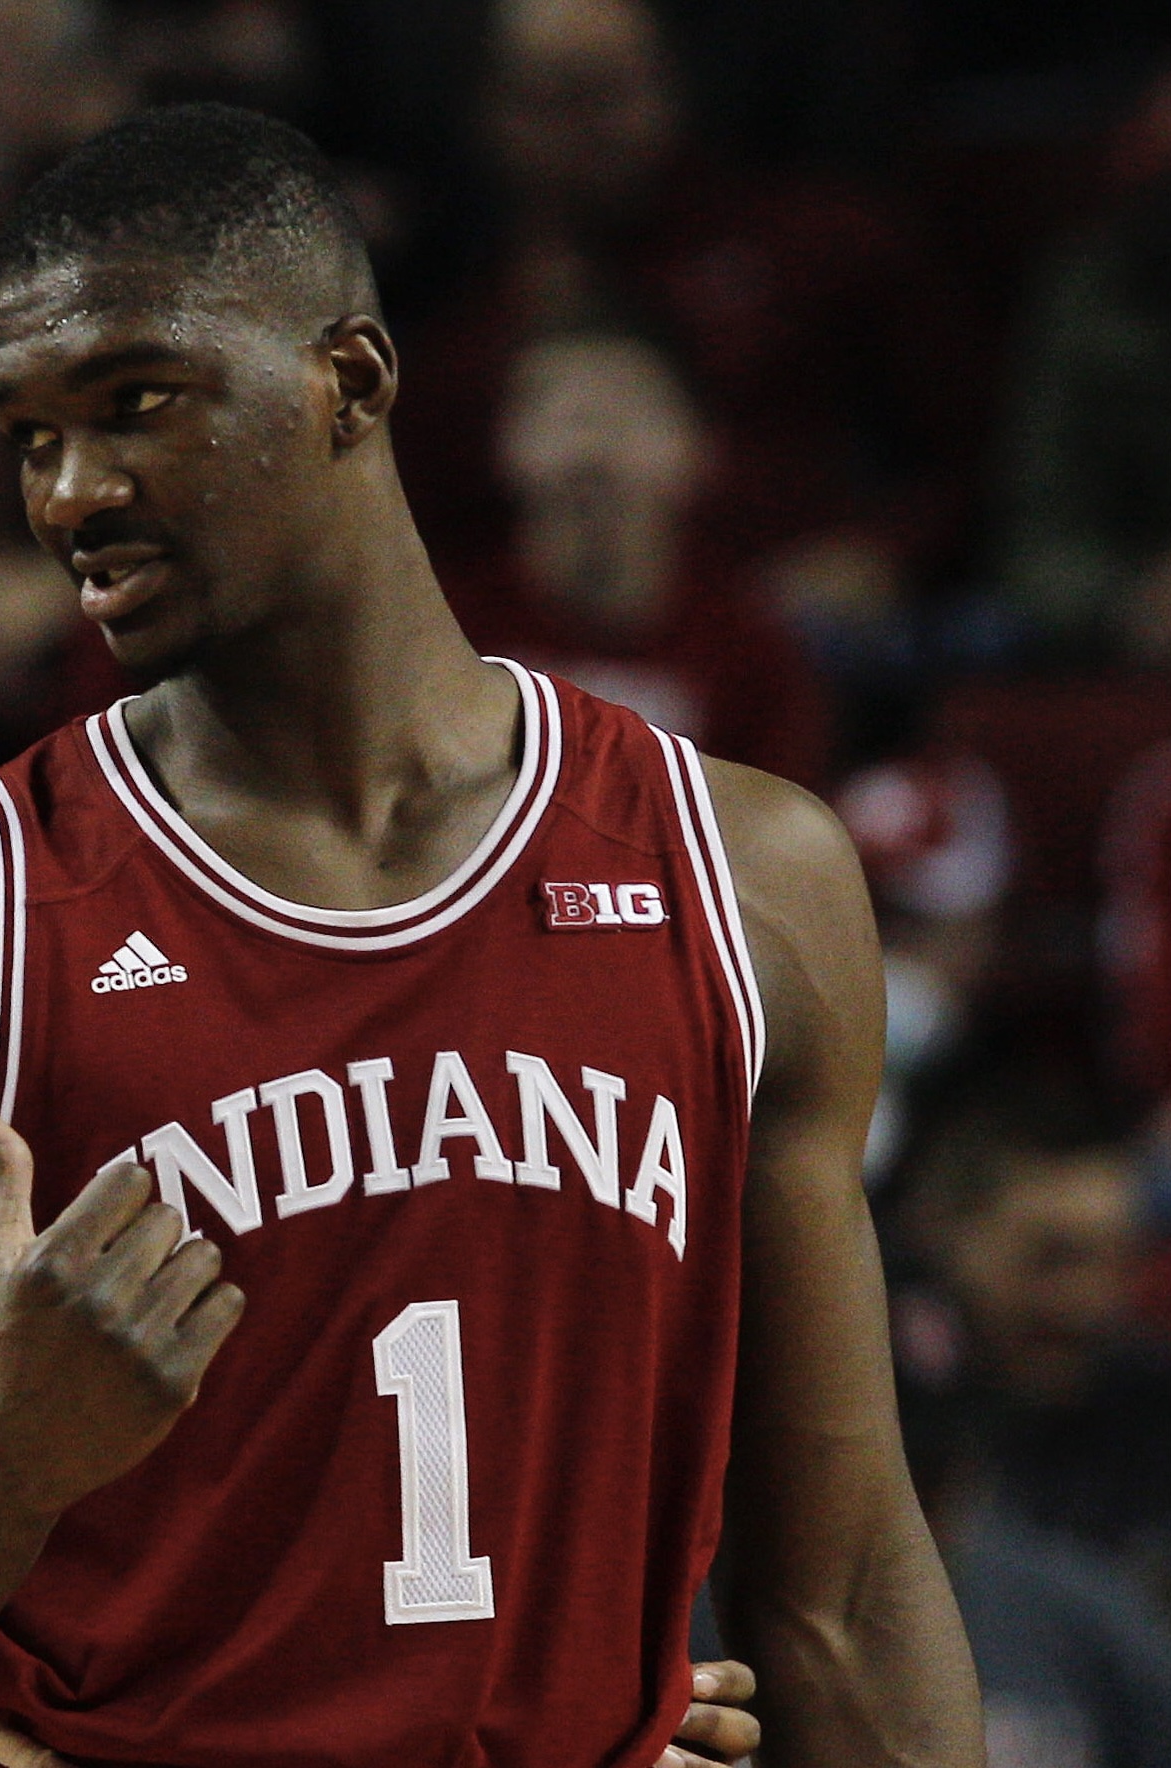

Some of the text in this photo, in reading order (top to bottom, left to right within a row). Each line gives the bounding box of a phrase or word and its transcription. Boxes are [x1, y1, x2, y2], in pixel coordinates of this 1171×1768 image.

[90, 963, 189, 994] adidas
[96, 1050, 687, 1262] NDIANA
[371, 1299, 496, 1626] 1
